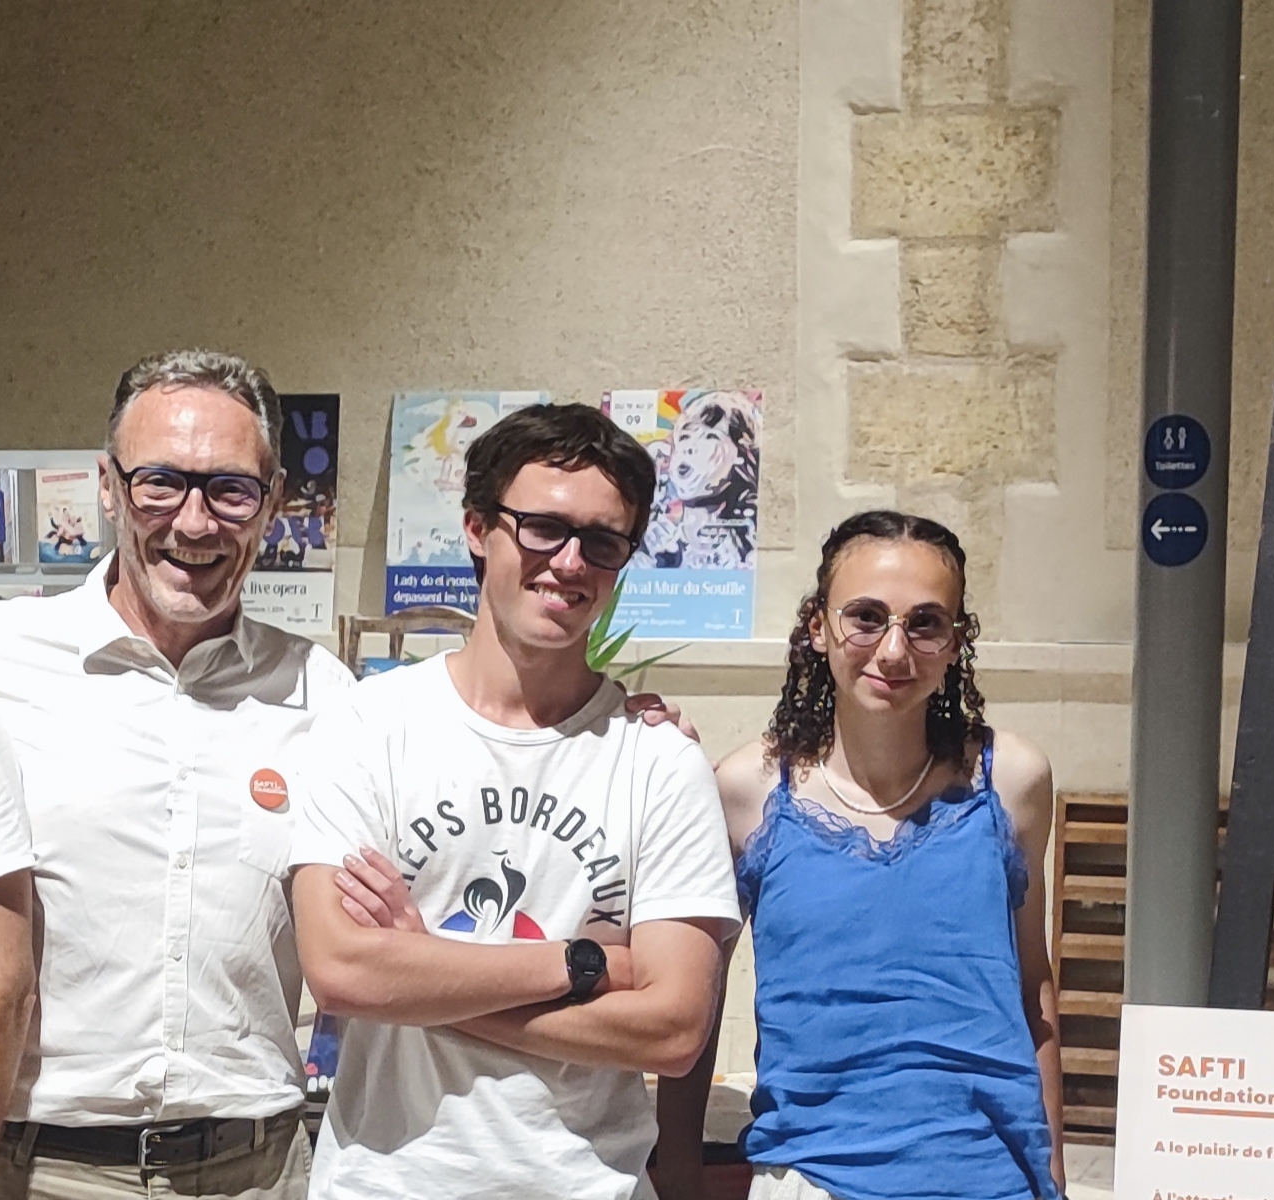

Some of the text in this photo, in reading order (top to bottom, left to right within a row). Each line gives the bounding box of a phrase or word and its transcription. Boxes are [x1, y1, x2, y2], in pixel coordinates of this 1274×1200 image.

[1155, 461, 1196, 471] Toilettes
[250, 581, 271, 595] live
[683, 580, 700, 595] du
[481, 786, 627, 927] BORDEAUX
[1157, 1054, 1246, 1080] SAFTI
[1154, 1141, 1166, 1153] A
[1170, 1141, 1184, 1153] le
[1187, 1142, 1240, 1157] plaisir
[1243, 1145, 1263, 1159] de
